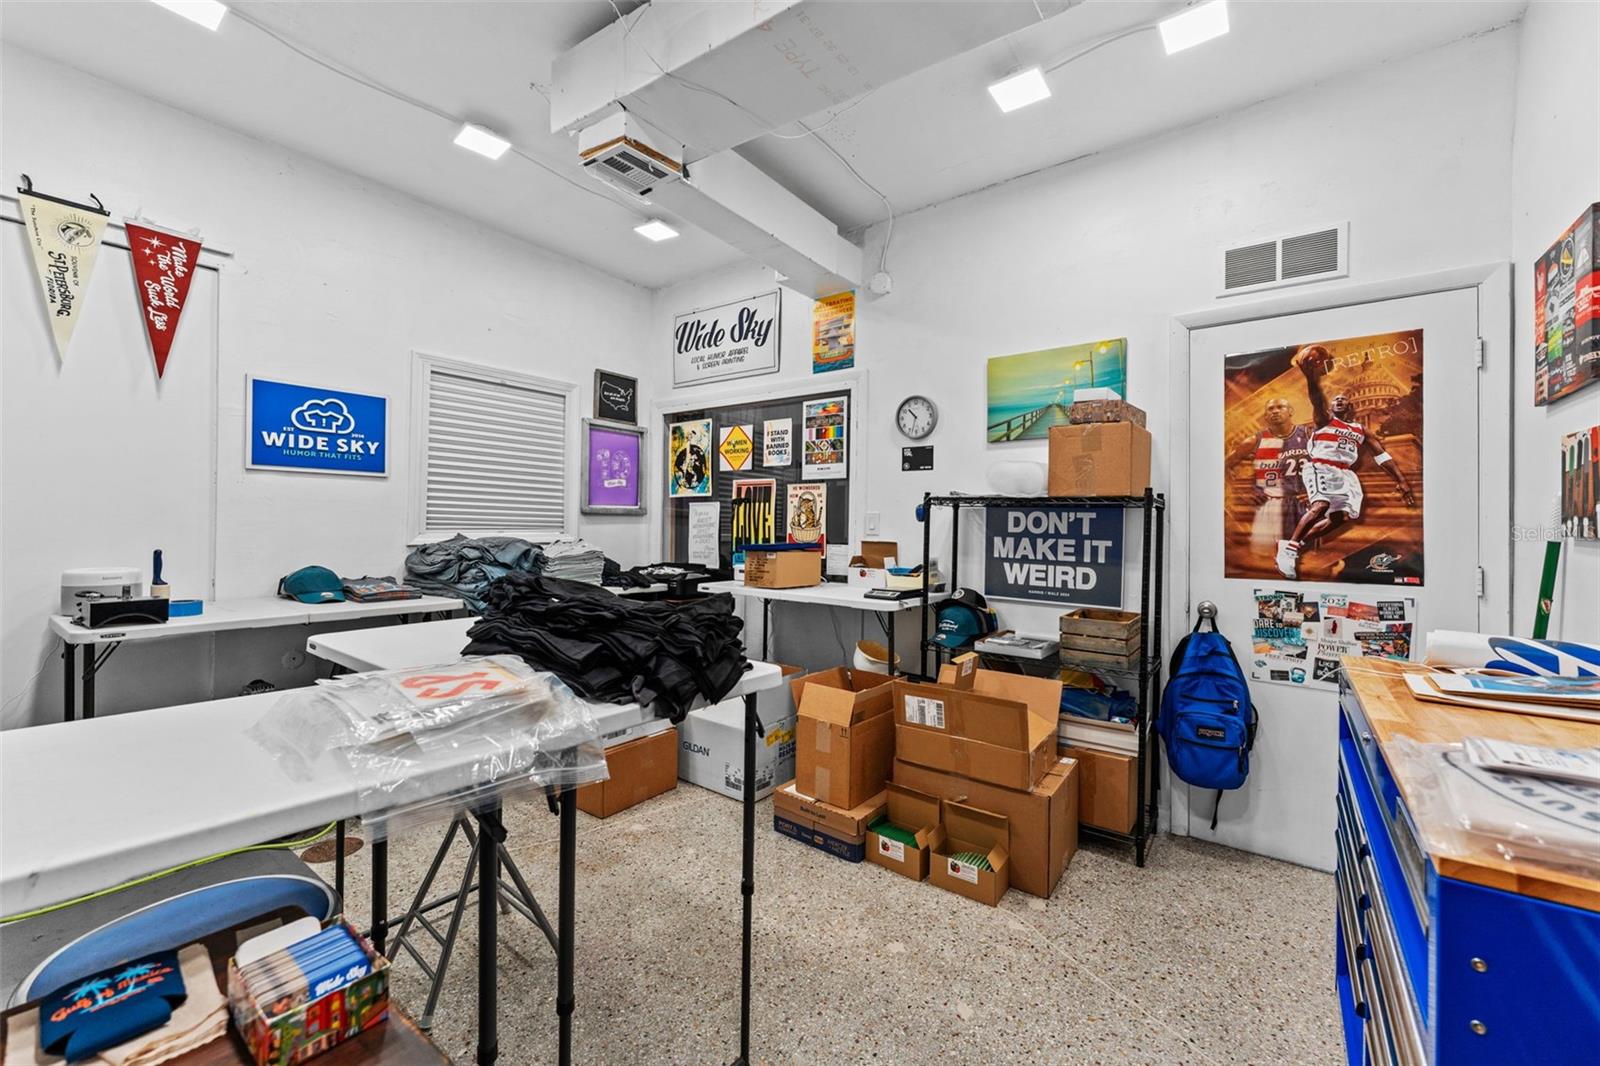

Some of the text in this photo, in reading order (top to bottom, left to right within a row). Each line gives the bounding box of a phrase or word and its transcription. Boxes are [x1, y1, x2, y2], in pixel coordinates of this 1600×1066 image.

[171, 241, 188, 278] Make
[160, 270, 181, 310] World
[144, 280, 168, 332] Suck Less
[675, 306, 774, 354] Wide Sky
[261, 430, 380, 455] WIDE SKY
[1337, 437, 1357, 453] 23
[283, 449, 362, 461] HUMOR THAT FITS
[1285, 458, 1310, 476] 23
[1265, 472, 1277, 488] 2
[1007, 511, 1097, 535] DON'T
[993, 536, 1113, 564] MAKE IT
[1003, 562, 1097, 590] WEIRD
[1254, 618, 1275, 629] DARE
[1318, 643, 1349, 653] POWER
[1318, 660, 1335, 668] LIKE
[682, 741, 710, 757] GILDAN
